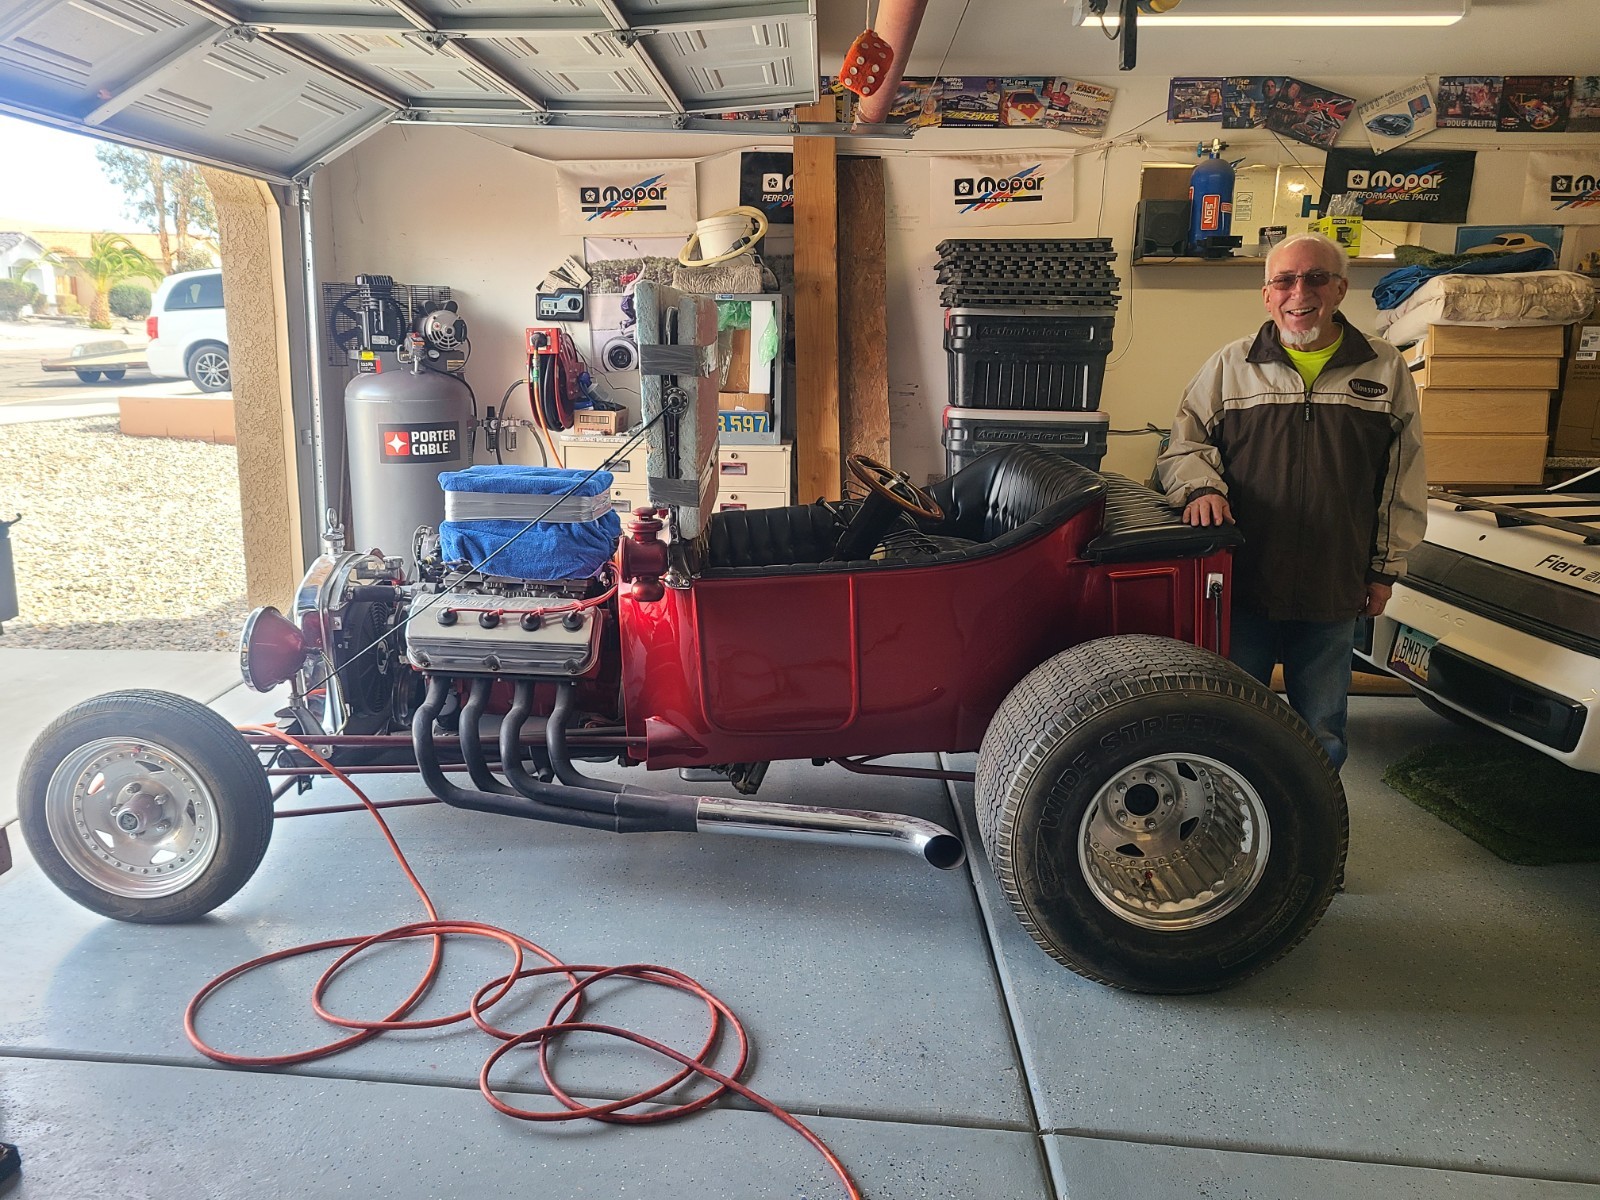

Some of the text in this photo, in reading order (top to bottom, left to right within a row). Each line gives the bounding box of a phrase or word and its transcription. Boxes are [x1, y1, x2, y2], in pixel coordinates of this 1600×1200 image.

[1446, 119, 1466, 127] DOUG
[1467, 119, 1496, 128] KALITTA
[977, 176, 1045, 194] Mopar
[1370, 170, 1442, 190] Mopar
[602, 186, 667, 203] Mopar
[1411, 193, 1440, 202] PARTS
[1204, 201, 1214, 224] NOS
[411, 429, 456, 443] PORTER
[411, 442, 449, 455] CABLE
[1535, 554, 1587, 577] Fiero
[1401, 595, 1467, 628] ONTIAC
[1039, 751, 1096, 829] WIDE
